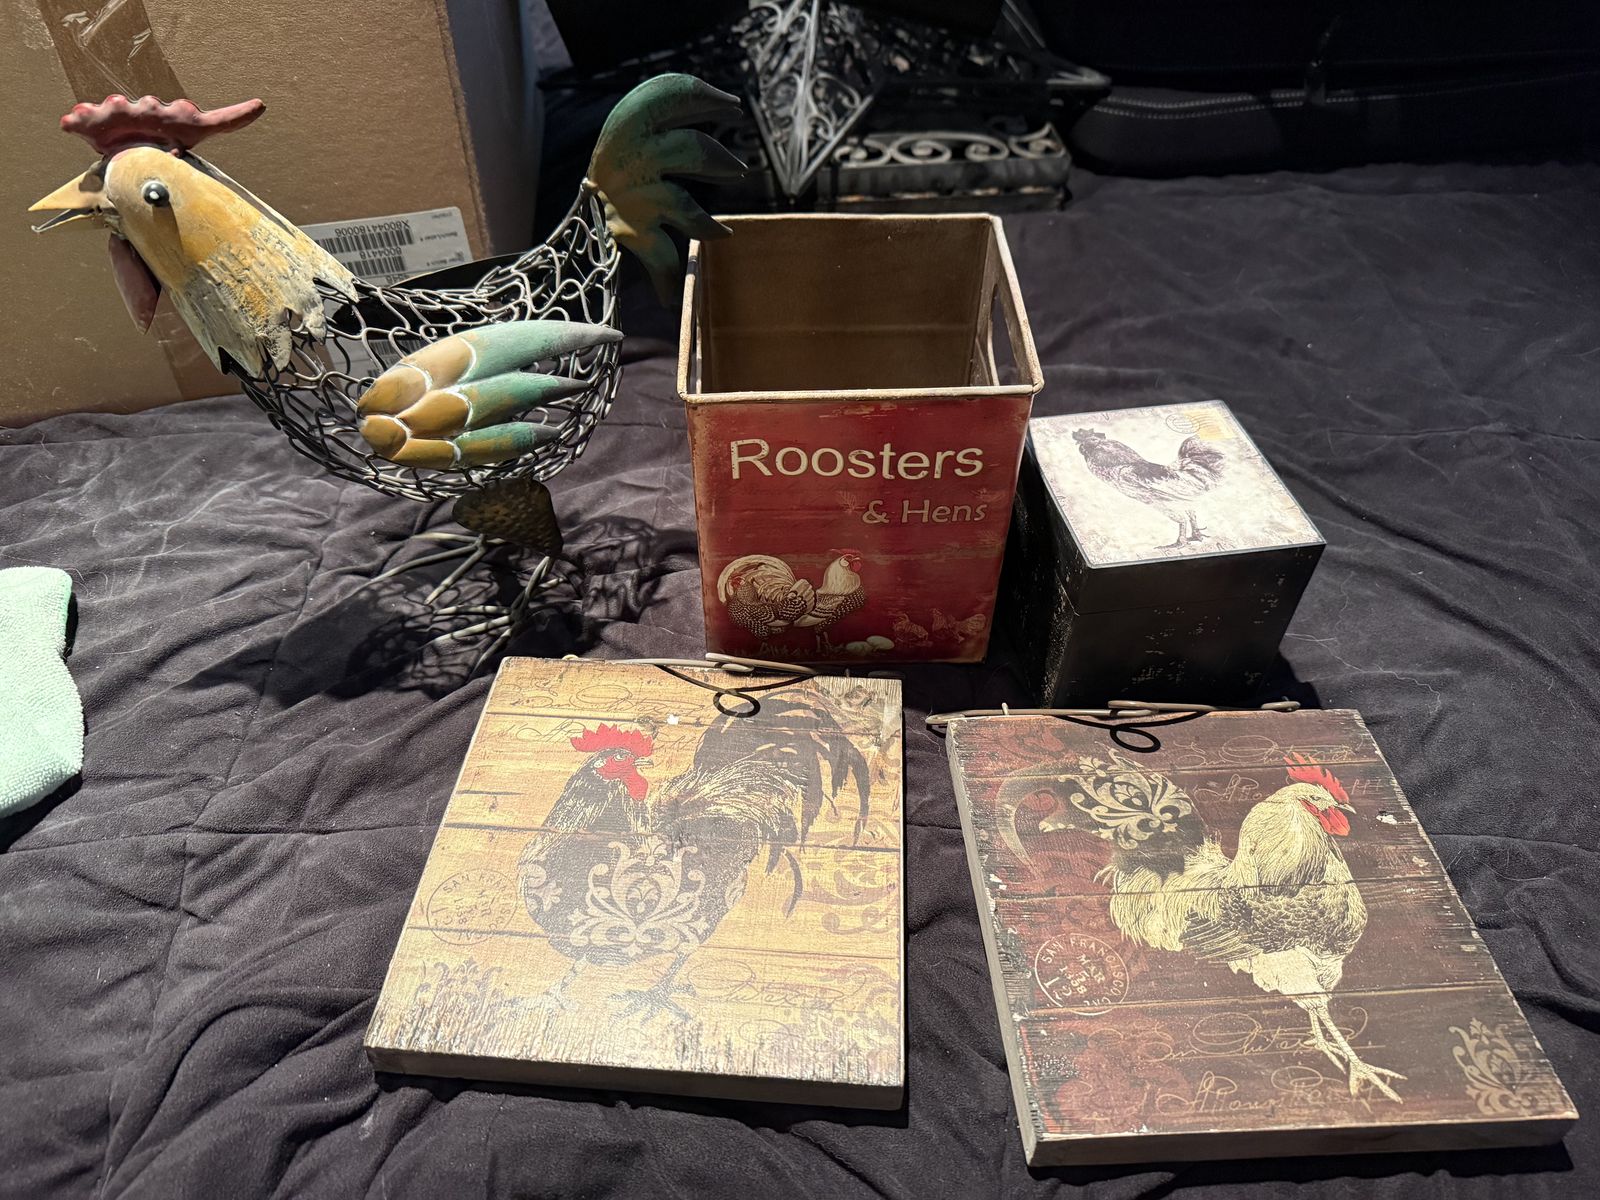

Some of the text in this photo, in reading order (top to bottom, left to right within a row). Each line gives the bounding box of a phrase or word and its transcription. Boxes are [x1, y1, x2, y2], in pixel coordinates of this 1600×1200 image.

[730, 438, 984, 481] Roosters
[862, 499, 988, 525] & Hens
[1041, 939, 1065, 964] SAN
